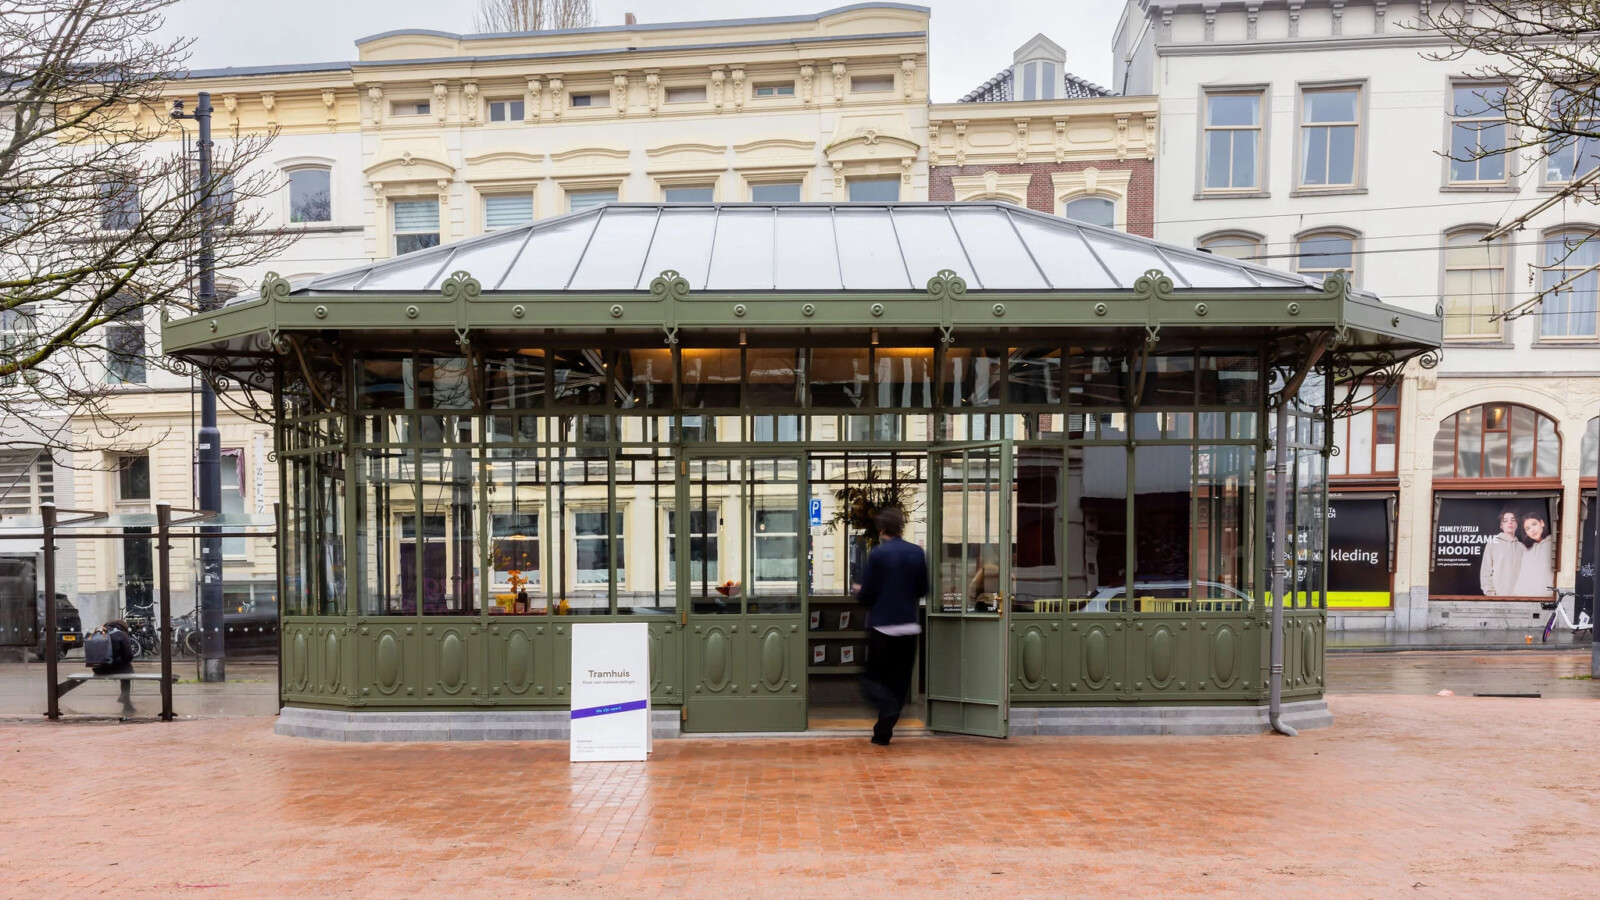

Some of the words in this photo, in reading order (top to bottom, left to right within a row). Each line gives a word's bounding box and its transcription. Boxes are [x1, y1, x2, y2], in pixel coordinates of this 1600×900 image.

[812, 501, 820, 515] P
[1438, 525, 1479, 533] STANLEY/STELLA
[1438, 534, 1499, 544] DUURZAME
[1438, 546, 1481, 555] HOODIE
[1330, 549, 1379, 564] kleding
[588, 669, 630, 678] Tramhuis
